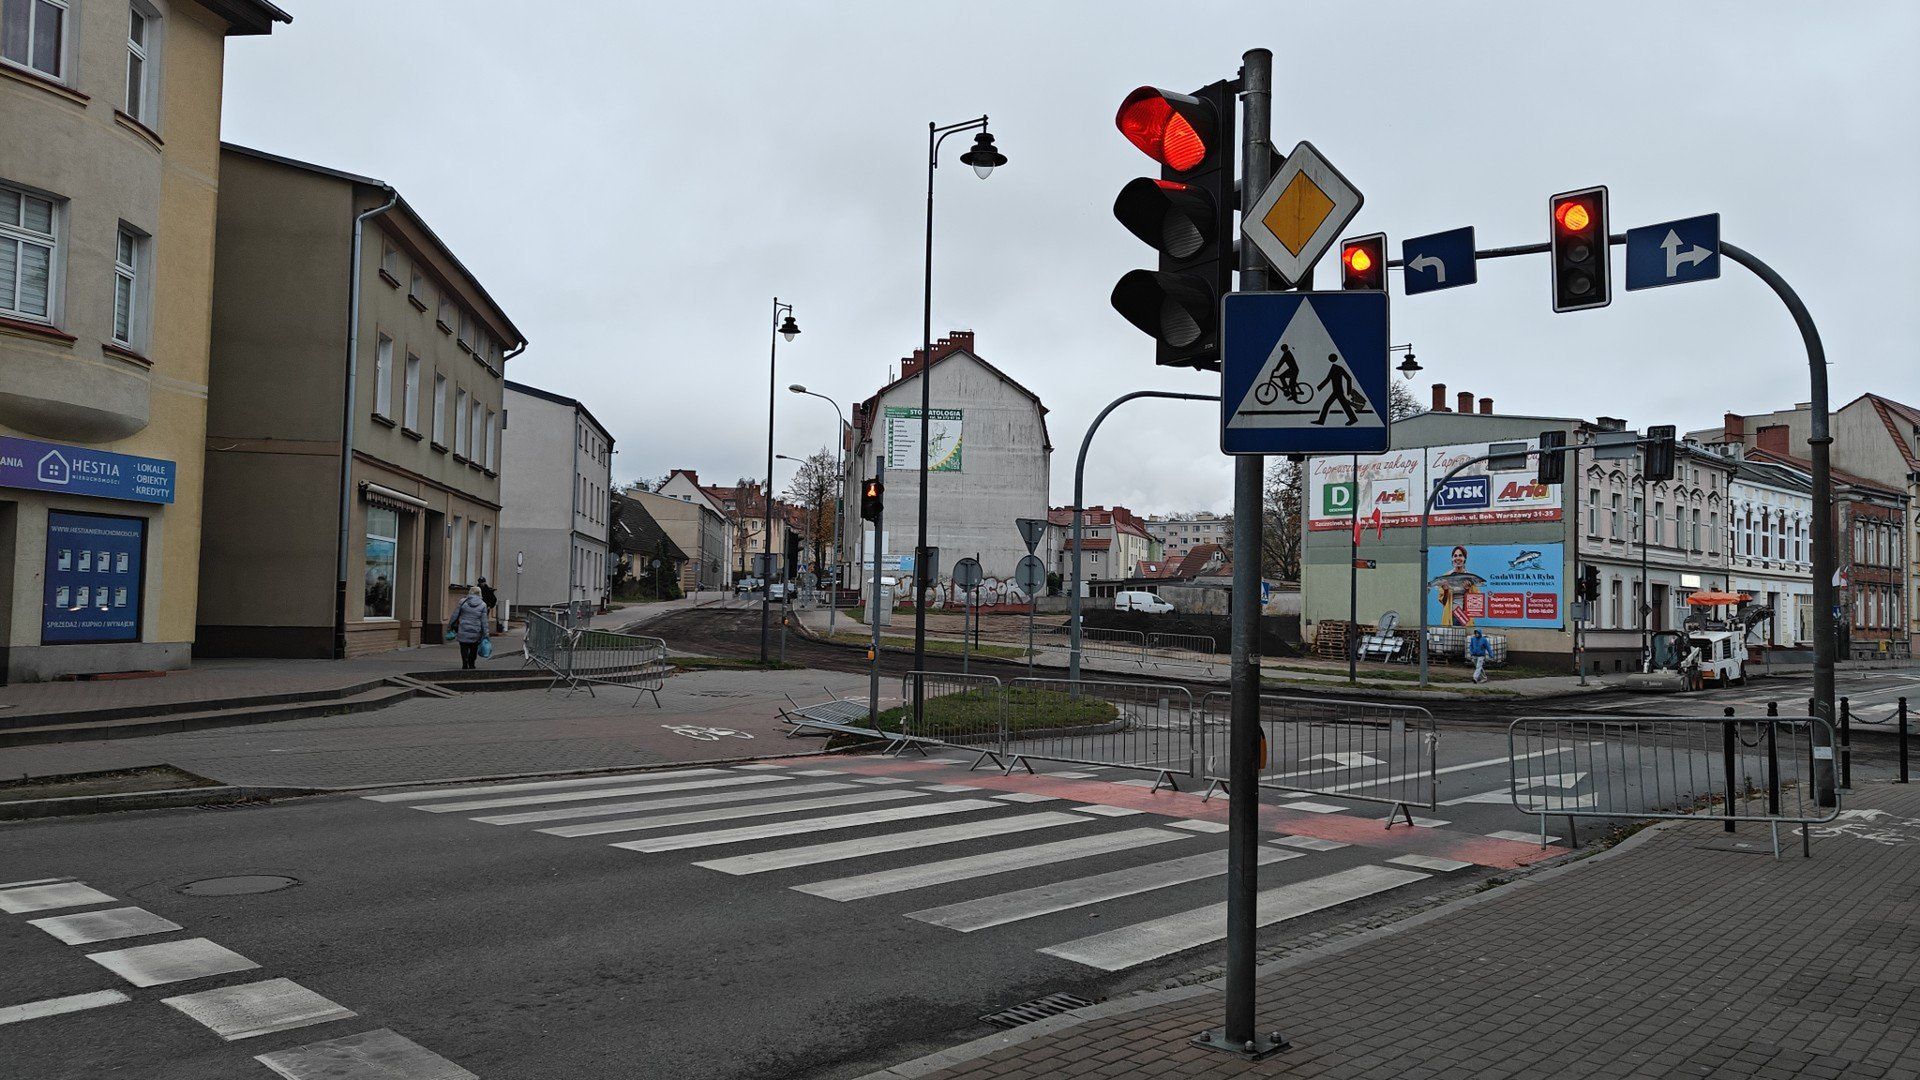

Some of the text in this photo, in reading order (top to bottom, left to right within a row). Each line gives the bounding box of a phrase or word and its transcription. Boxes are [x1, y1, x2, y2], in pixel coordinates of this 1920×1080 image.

[72, 459, 120, 477] HESTIA
[137, 463, 166, 475] LOKALE
[1371, 462, 1382, 471] na
[1384, 454, 1418, 474] zakupy
[136, 475, 168, 486] OBIEKTY
[136, 486, 170, 498] KREDYTY
[1331, 486, 1350, 506] D
[1375, 488, 1406, 503] Aria
[1447, 485, 1484, 499] JYSK
[1498, 479, 1550, 500] Aria
[1480, 512, 1495, 520] Boh.
[1496, 511, 1532, 520] Warszawy
[1537, 573, 1555, 581] Ryba
[106, 620, 134, 628] WYNAJEM
